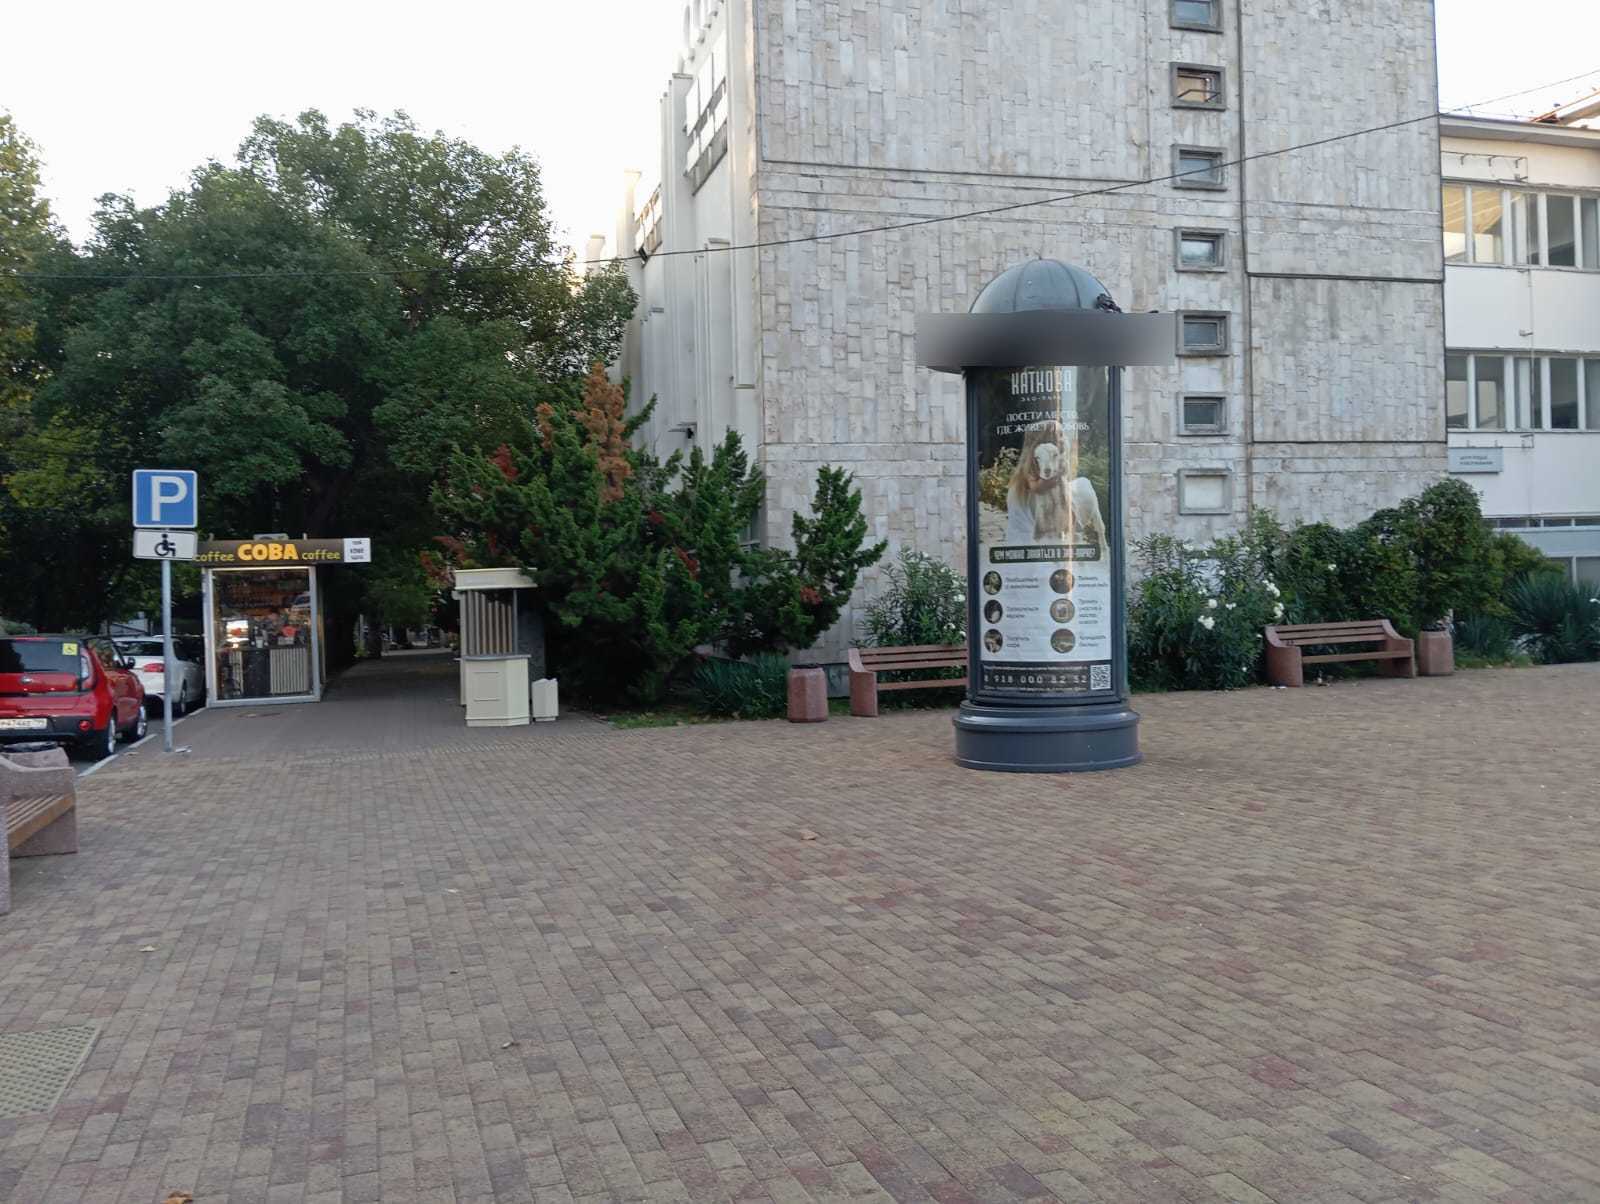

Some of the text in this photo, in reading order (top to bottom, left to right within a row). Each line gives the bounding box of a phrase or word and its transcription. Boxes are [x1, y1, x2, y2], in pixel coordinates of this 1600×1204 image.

[151, 476, 188, 522] P
[193, 551, 235, 562] coffee
[302, 549, 341, 560] coffee
